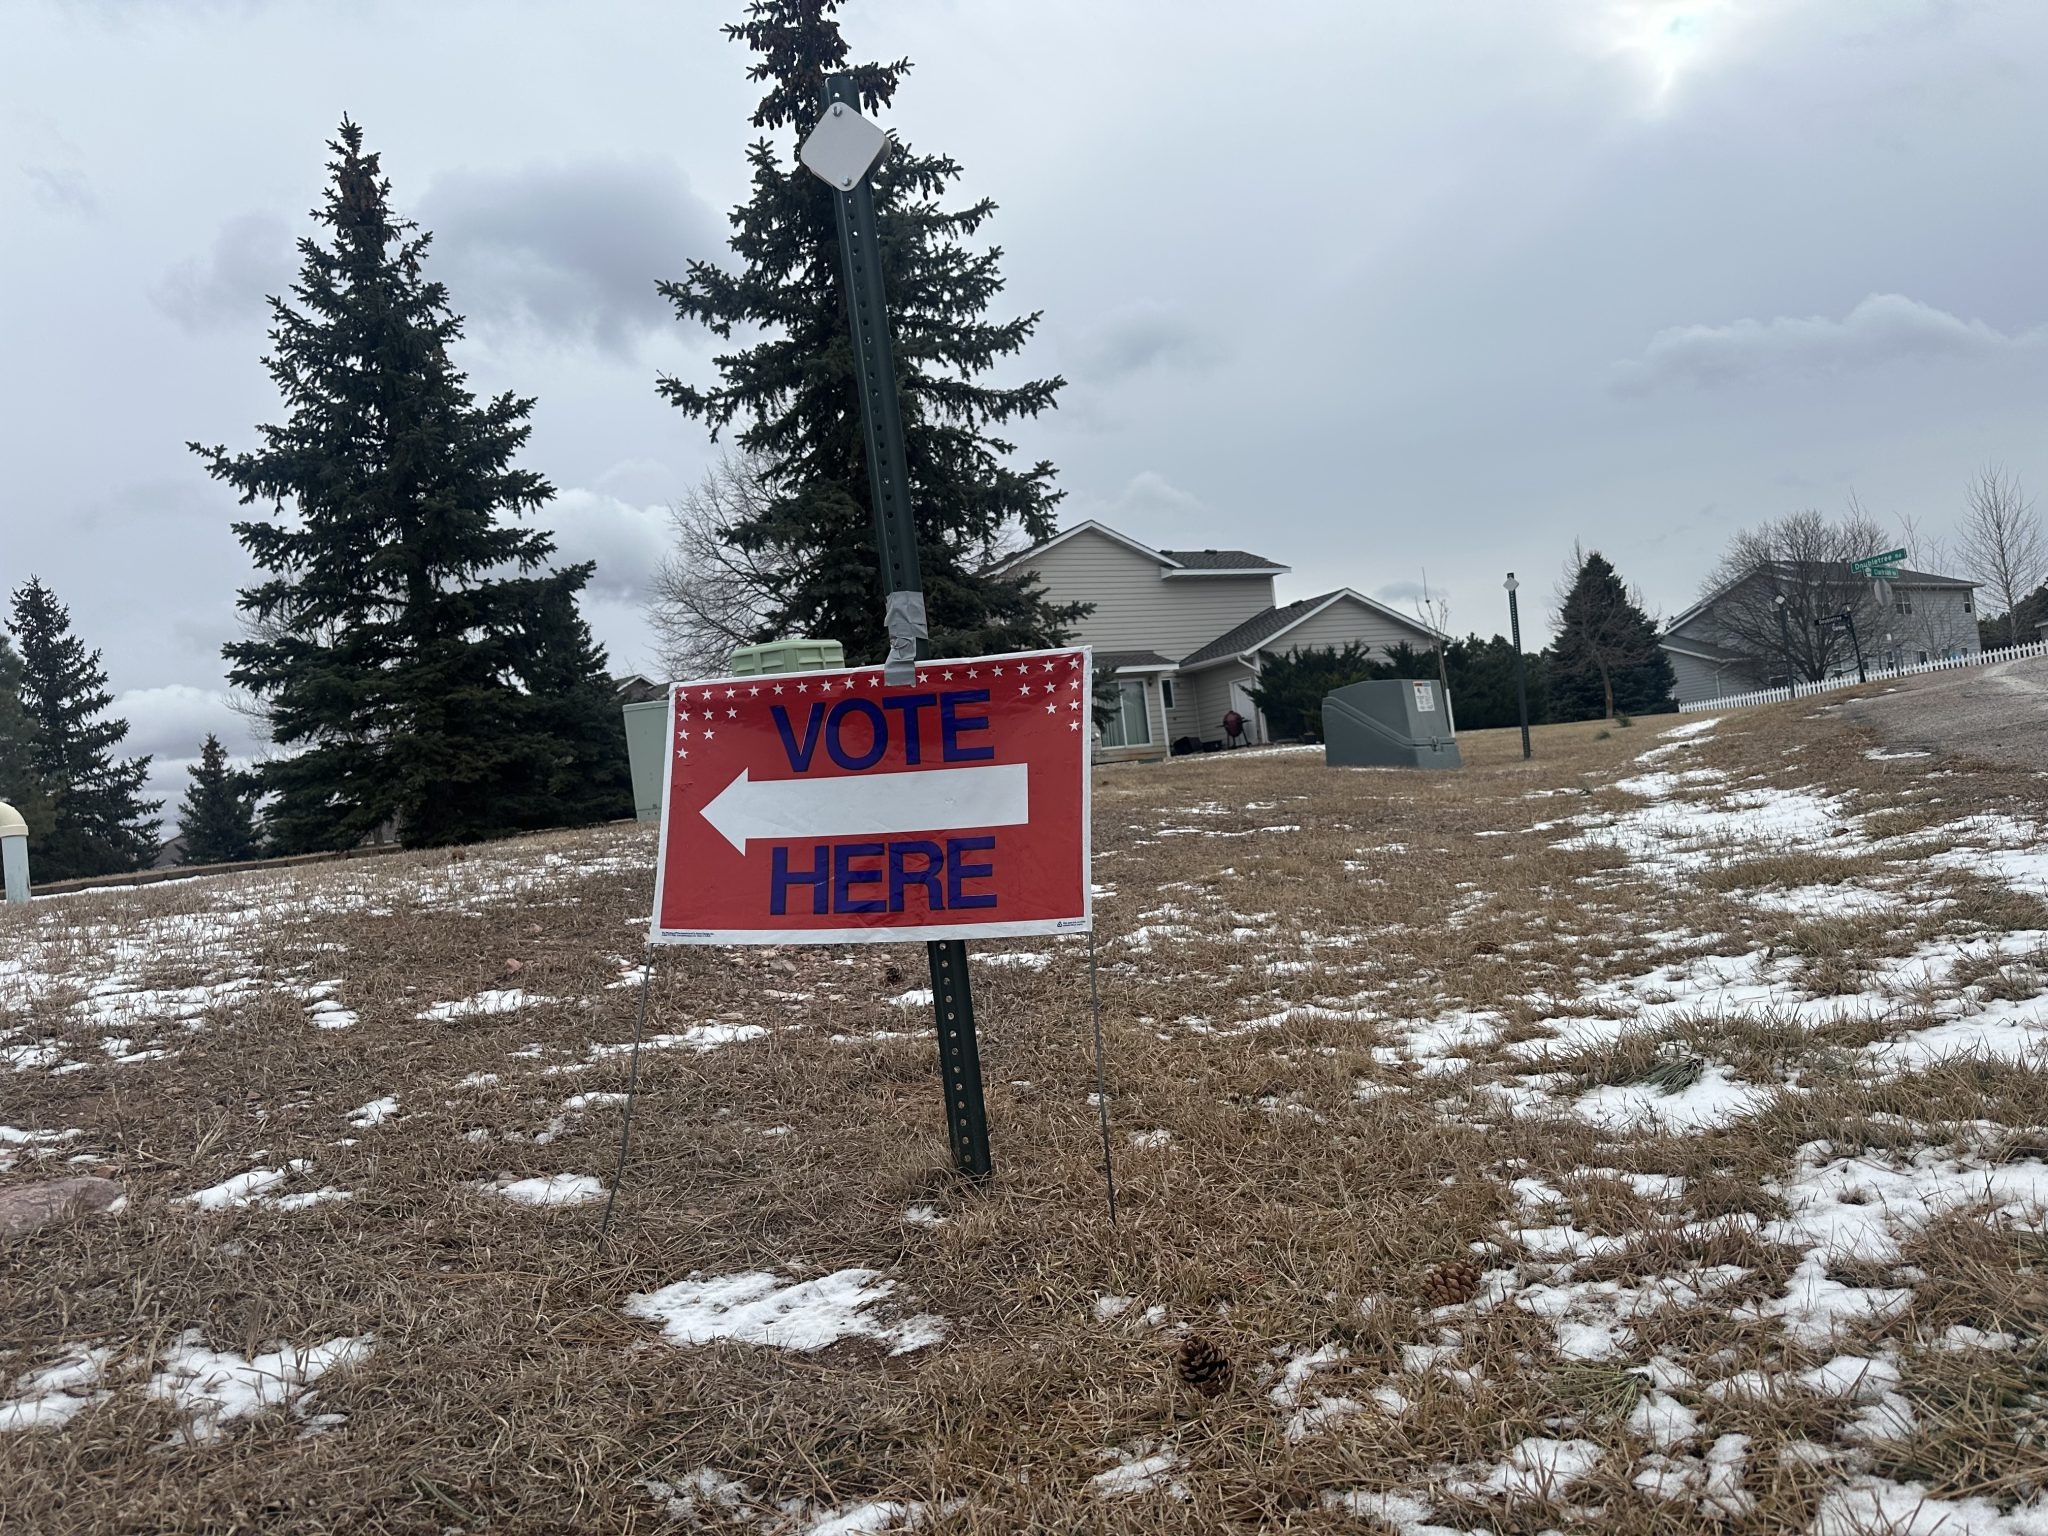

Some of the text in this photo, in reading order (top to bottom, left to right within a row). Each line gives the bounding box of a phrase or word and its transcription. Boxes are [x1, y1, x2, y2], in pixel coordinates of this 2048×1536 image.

[1854, 555, 1892, 570] Doubletree
[770, 689, 995, 772] VOTE
[770, 836, 998, 915] HERE
